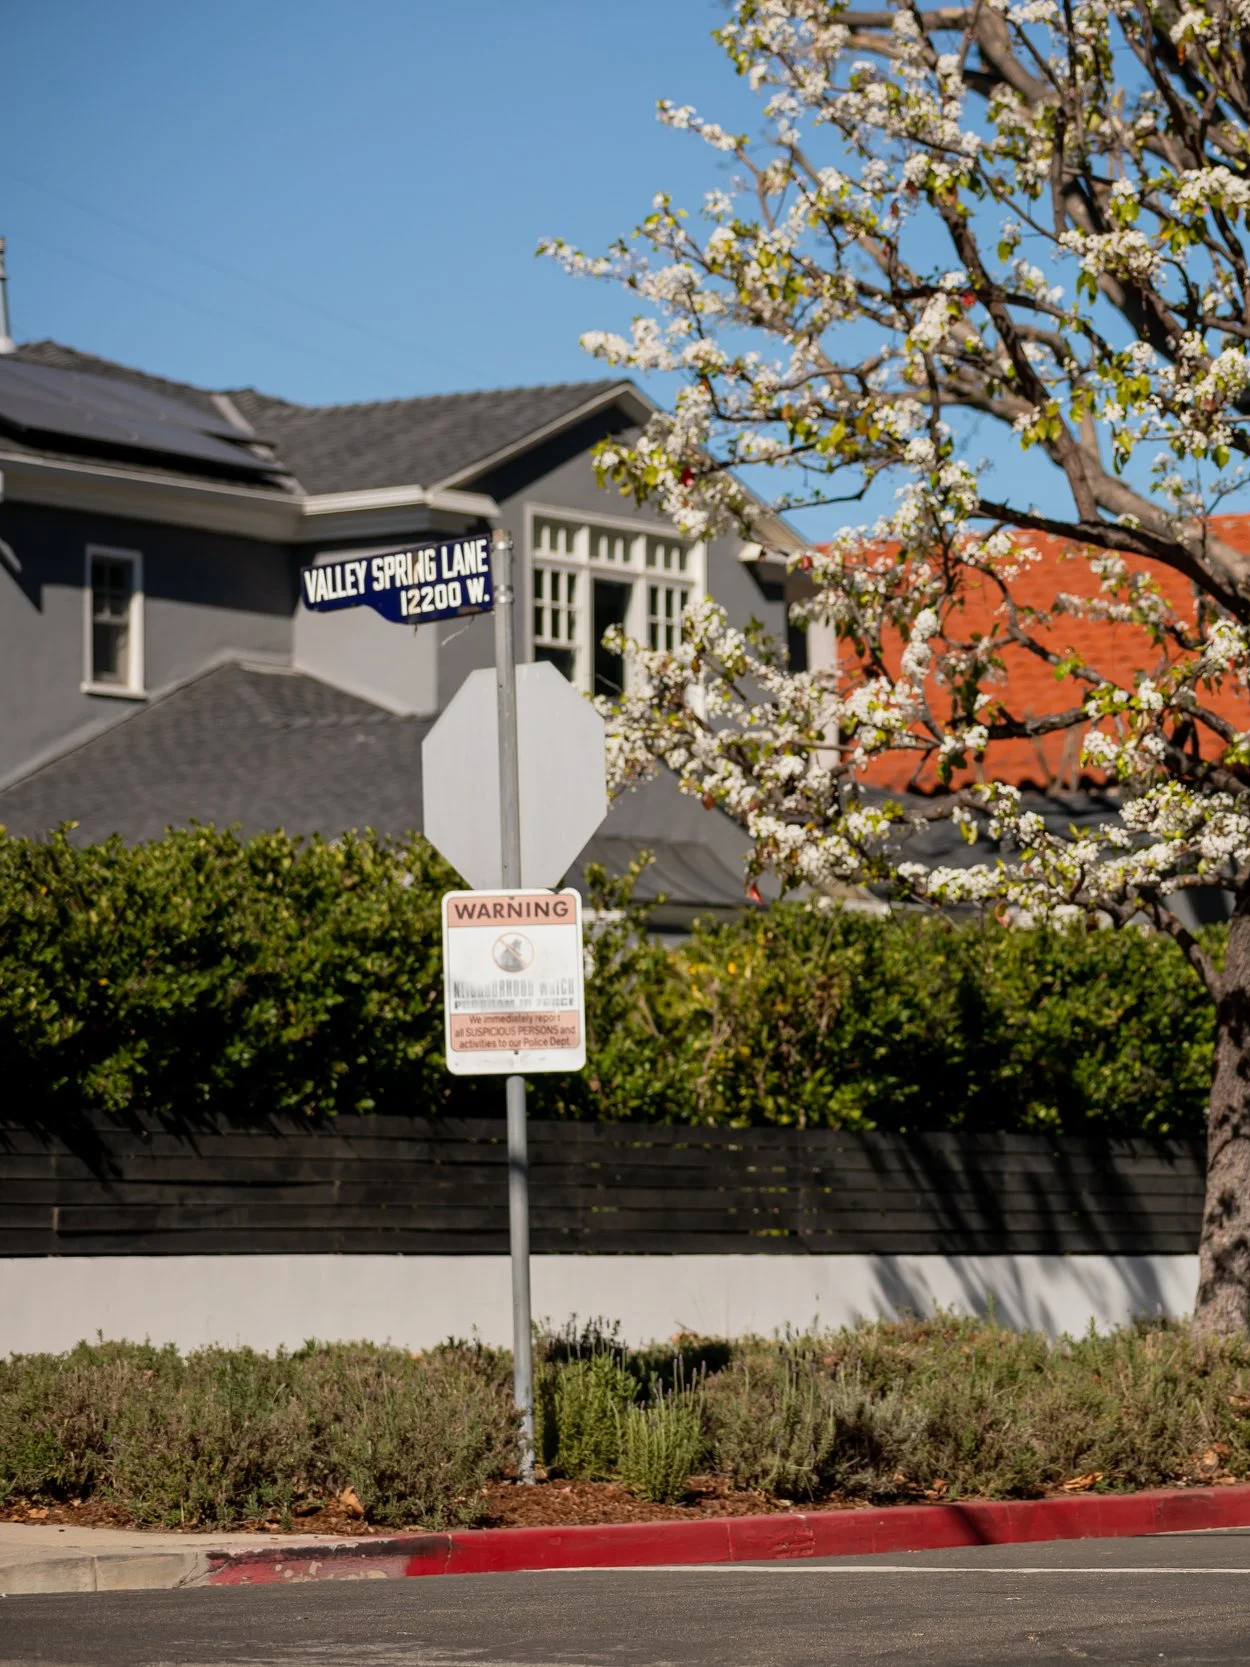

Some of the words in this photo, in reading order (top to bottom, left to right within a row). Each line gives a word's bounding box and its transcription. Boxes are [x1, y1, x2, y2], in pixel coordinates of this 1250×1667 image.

[304, 560, 368, 604] VALLEY
[371, 547, 437, 592] SPRING
[441, 539, 489, 580] LANE
[400, 581, 463, 617] 12200
[466, 577, 490, 605] W.
[454, 901, 569, 920] WARNING
[469, 1015, 482, 1024] We
[483, 1014, 535, 1025] immediately
[535, 1014, 561, 1025] repot
[454, 1029, 465, 1038] all
[465, 1026, 517, 1038] SUSPICIOUS
[518, 1025, 559, 1036] PERSONS
[560, 1025, 576, 1035] and
[459, 1040, 497, 1049] activities
[498, 1038, 508, 1048] to
[508, 1040, 523, 1048] our
[523, 1037, 549, 1047] Police
